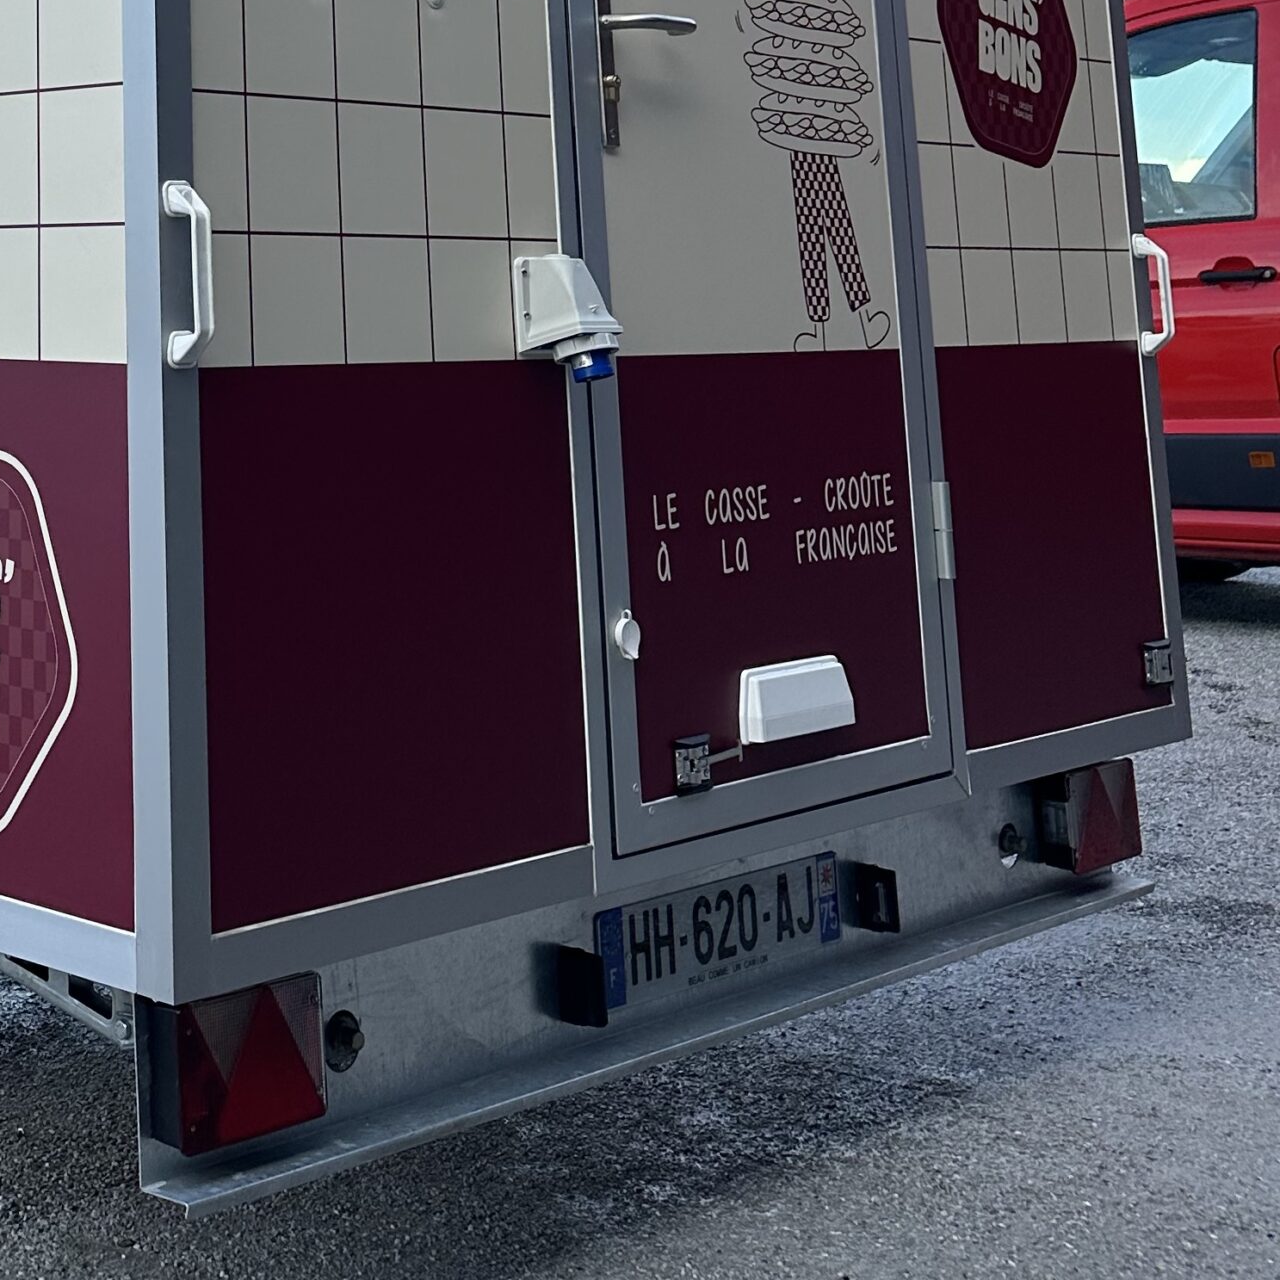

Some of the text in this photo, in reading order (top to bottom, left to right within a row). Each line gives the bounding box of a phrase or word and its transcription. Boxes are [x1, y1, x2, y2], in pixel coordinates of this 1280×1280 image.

[978, 18, 1042, 94] BONS
[653, 493, 680, 530] LE
[824, 471, 894, 512] CROÛTE
[610, 866, 838, 989] F HH-620-AJ 75
